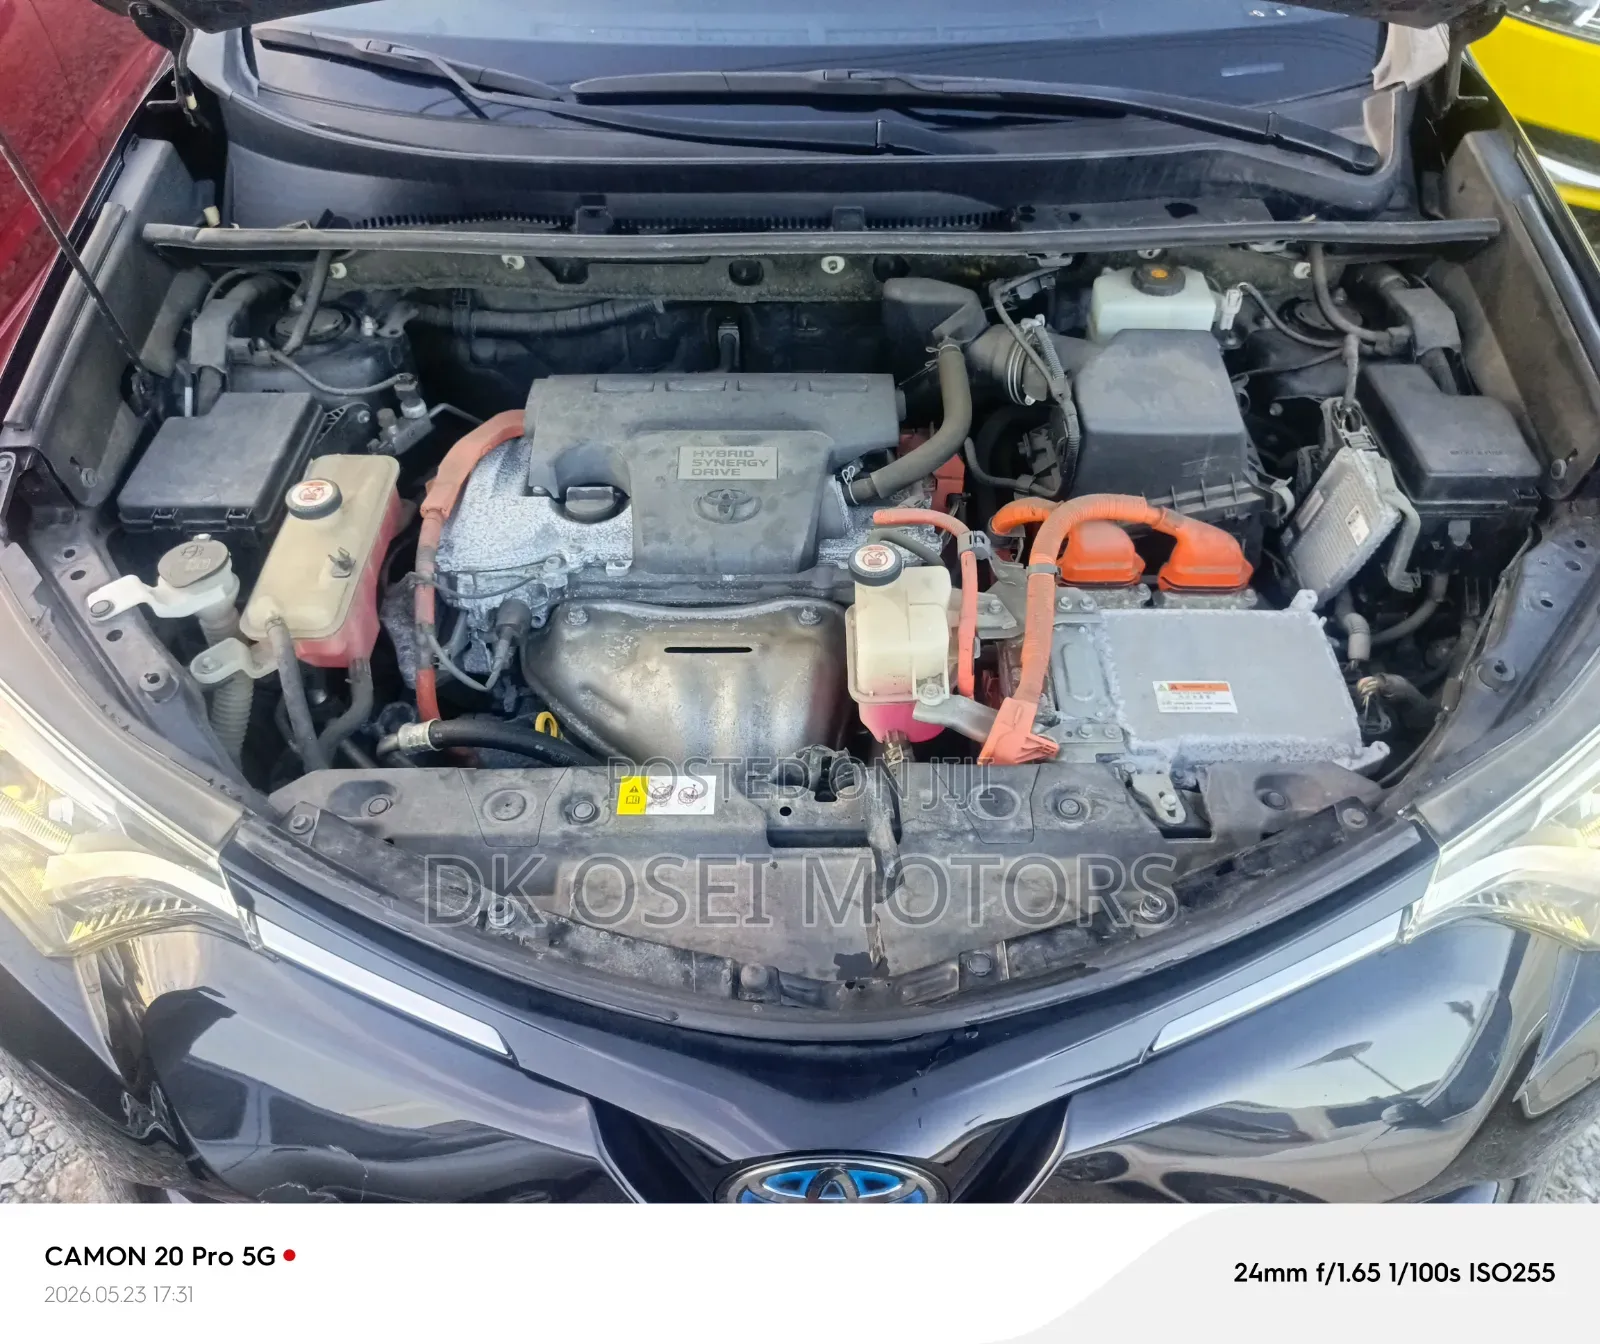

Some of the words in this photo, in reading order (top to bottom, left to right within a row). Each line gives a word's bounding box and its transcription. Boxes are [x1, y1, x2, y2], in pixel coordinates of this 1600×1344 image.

[693, 450, 755, 458] HYBRID
[692, 459, 768, 467] SYNERGY
[691, 468, 741, 476] DRIVE
